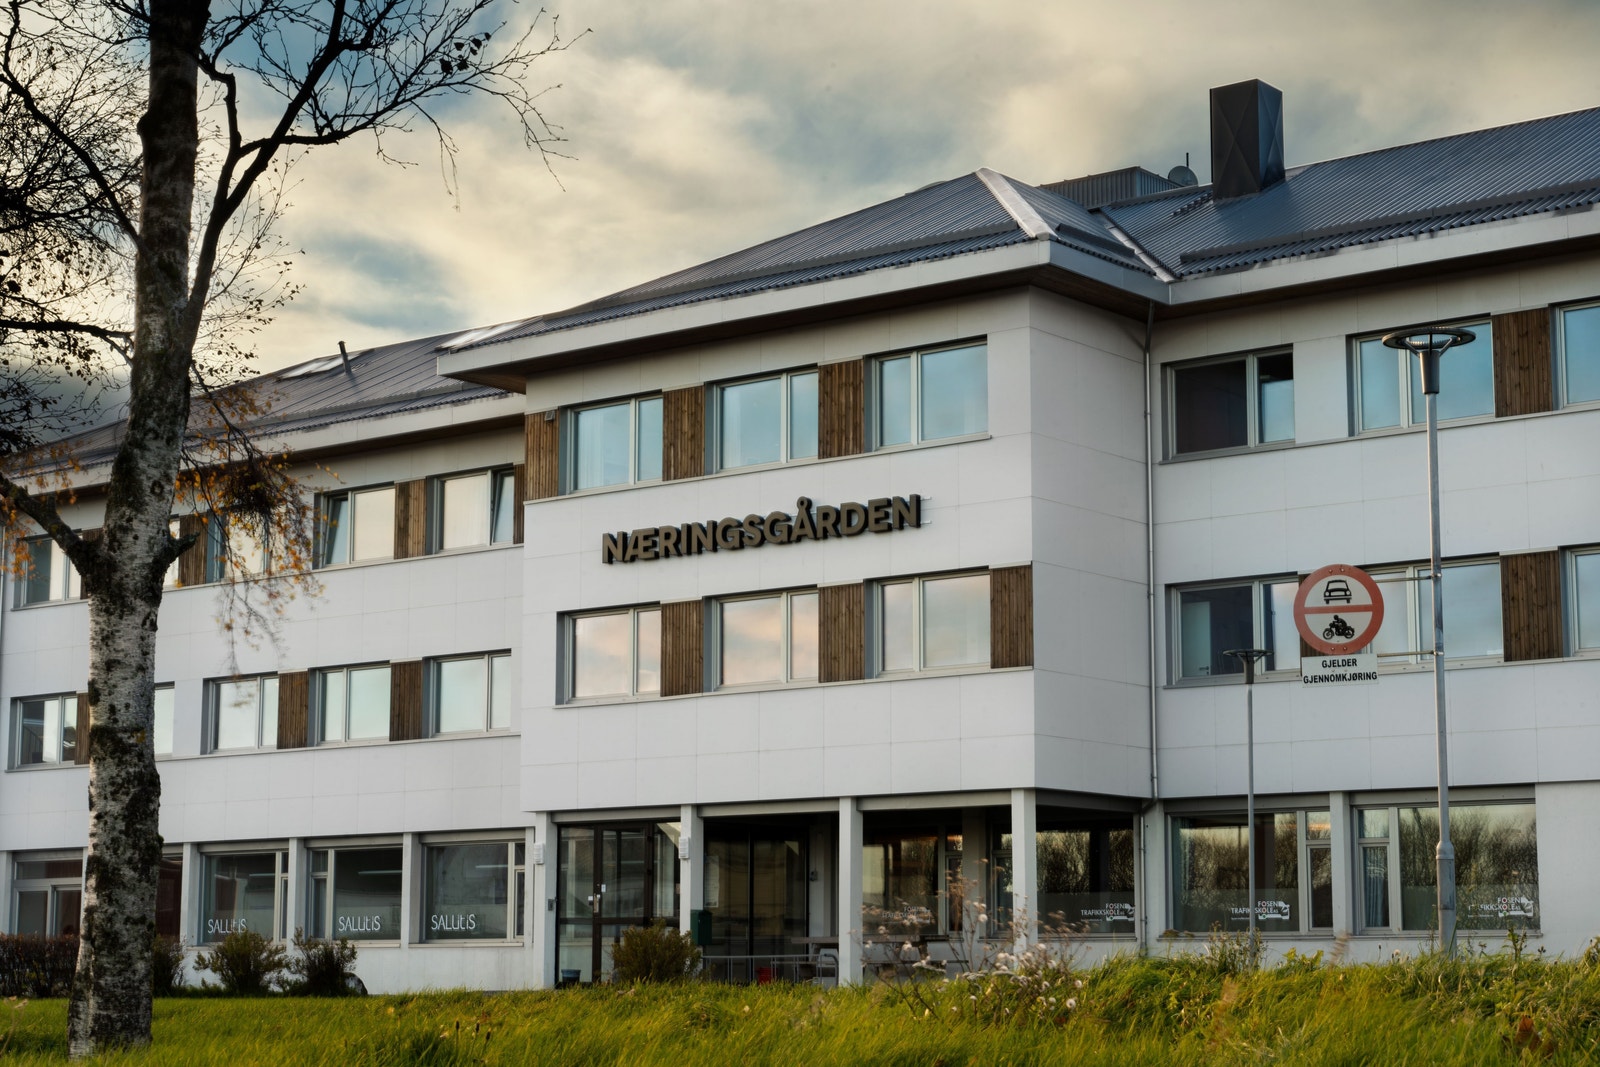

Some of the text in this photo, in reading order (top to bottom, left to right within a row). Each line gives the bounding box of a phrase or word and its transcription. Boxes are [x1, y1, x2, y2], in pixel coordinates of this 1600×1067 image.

[602, 494, 921, 564] NÆRINGSGÅRDEN
[1322, 658, 1357, 668] GJELDER
[1303, 671, 1378, 684] GJENNOMKJØRING
